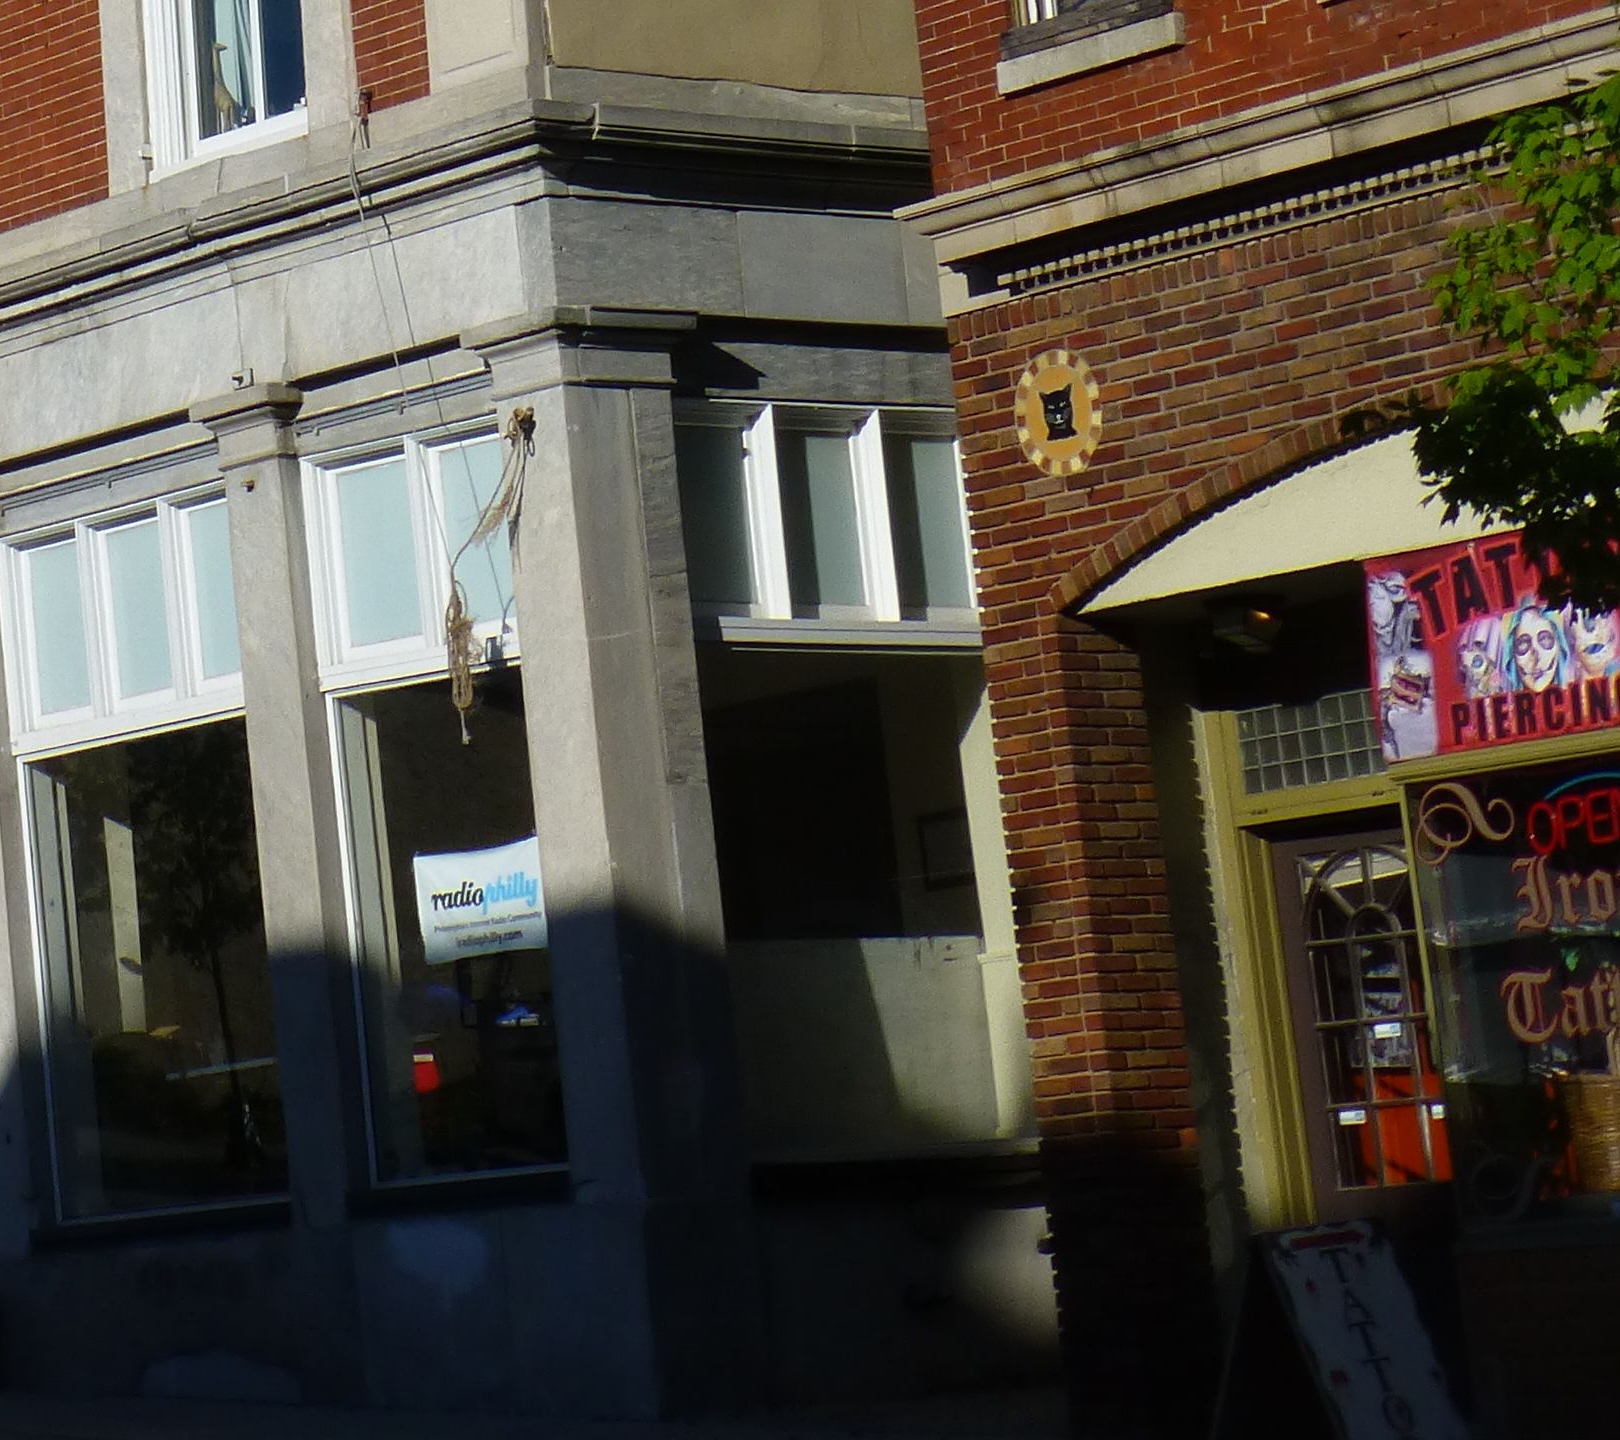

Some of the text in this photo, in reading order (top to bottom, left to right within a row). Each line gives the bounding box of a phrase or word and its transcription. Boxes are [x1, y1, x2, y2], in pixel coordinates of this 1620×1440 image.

[1452, 673, 1620, 746] PIERCIN
[1511, 854, 1620, 932] Iro
[1319, 1247, 1416, 1440] TATTO
